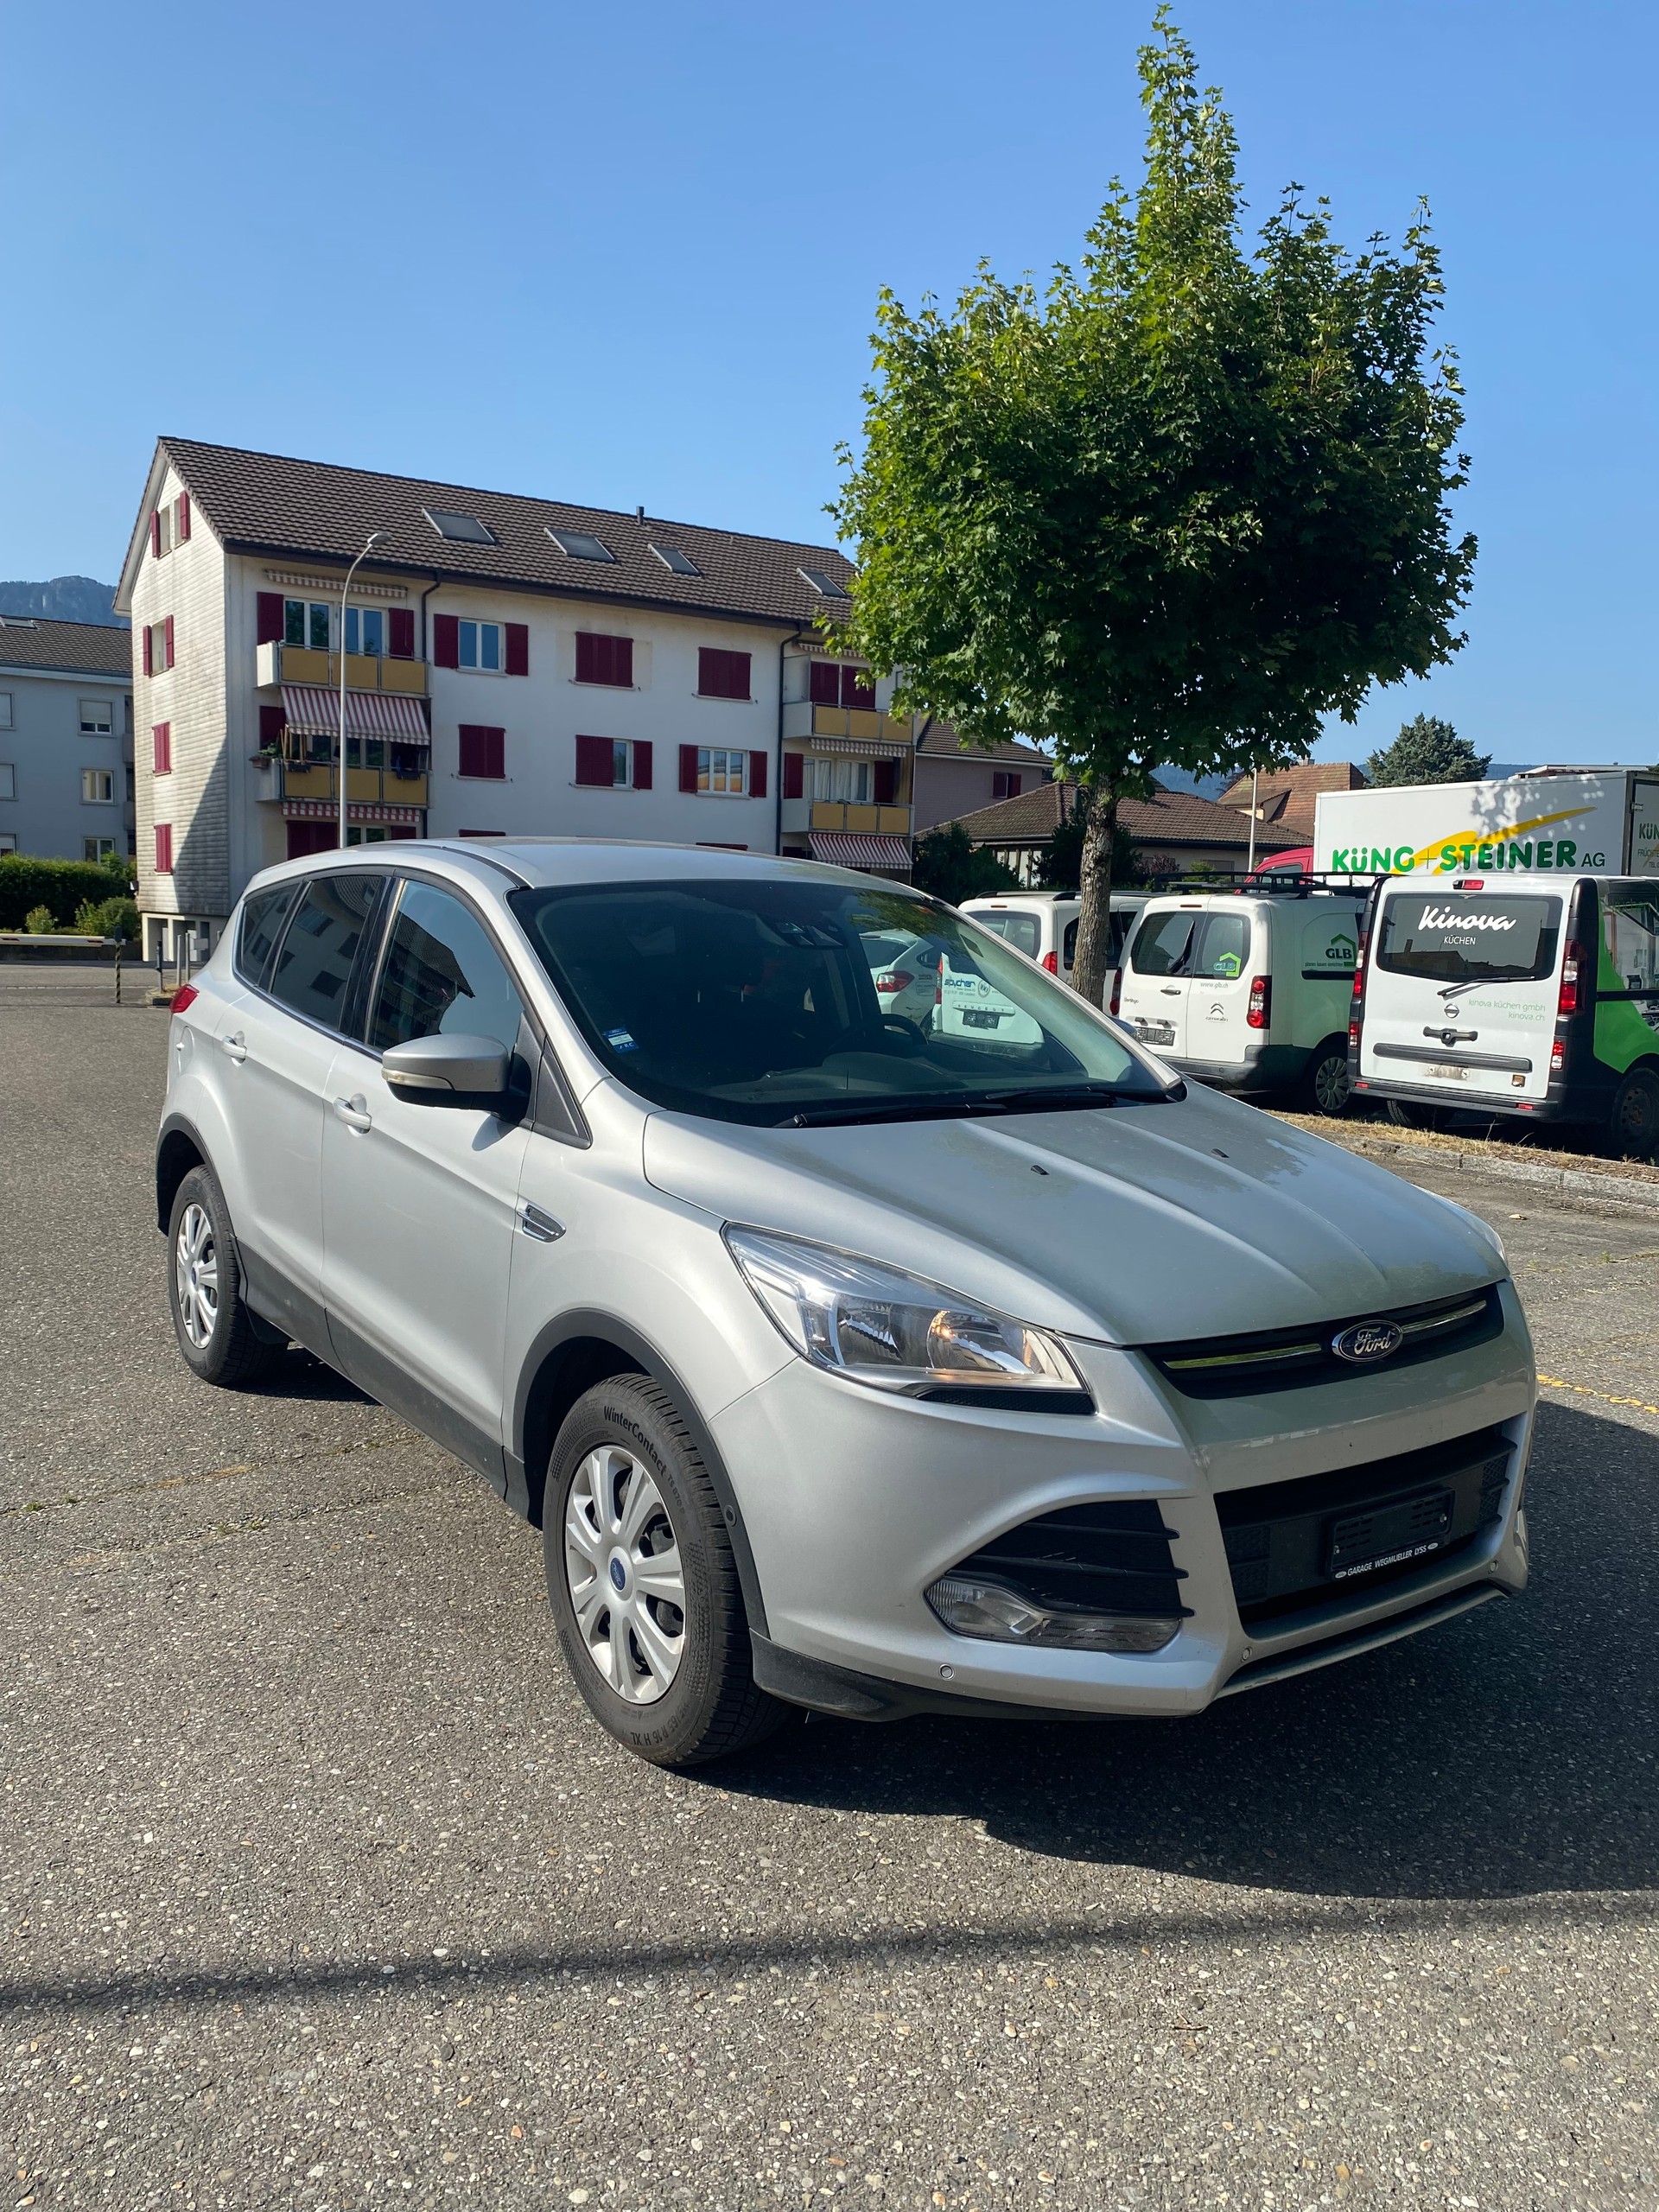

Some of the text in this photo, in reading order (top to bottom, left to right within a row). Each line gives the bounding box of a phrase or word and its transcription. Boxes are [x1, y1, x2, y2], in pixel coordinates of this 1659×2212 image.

[1440, 840, 1577, 871] STEINER
[1580, 852, 1605, 868] AG
[1418, 905, 1517, 931] Kinova
[1443, 934, 1477, 945] KÜCHEN
[1325, 948, 1352, 959] GLB
[1213, 962, 1236, 971] GLB
[1468, 999, 1546, 1013] kinova küchen gmbh
[1354, 1327, 1391, 1354] Ford
[604, 1406, 667, 1478] WinterContact
[1347, 1562, 1372, 1576] GARAGE
[1375, 1549, 1413, 1568] WEGMUELLER
[1414, 1545, 1427, 1555] LYSS
[631, 1732, 642, 1746] XL
